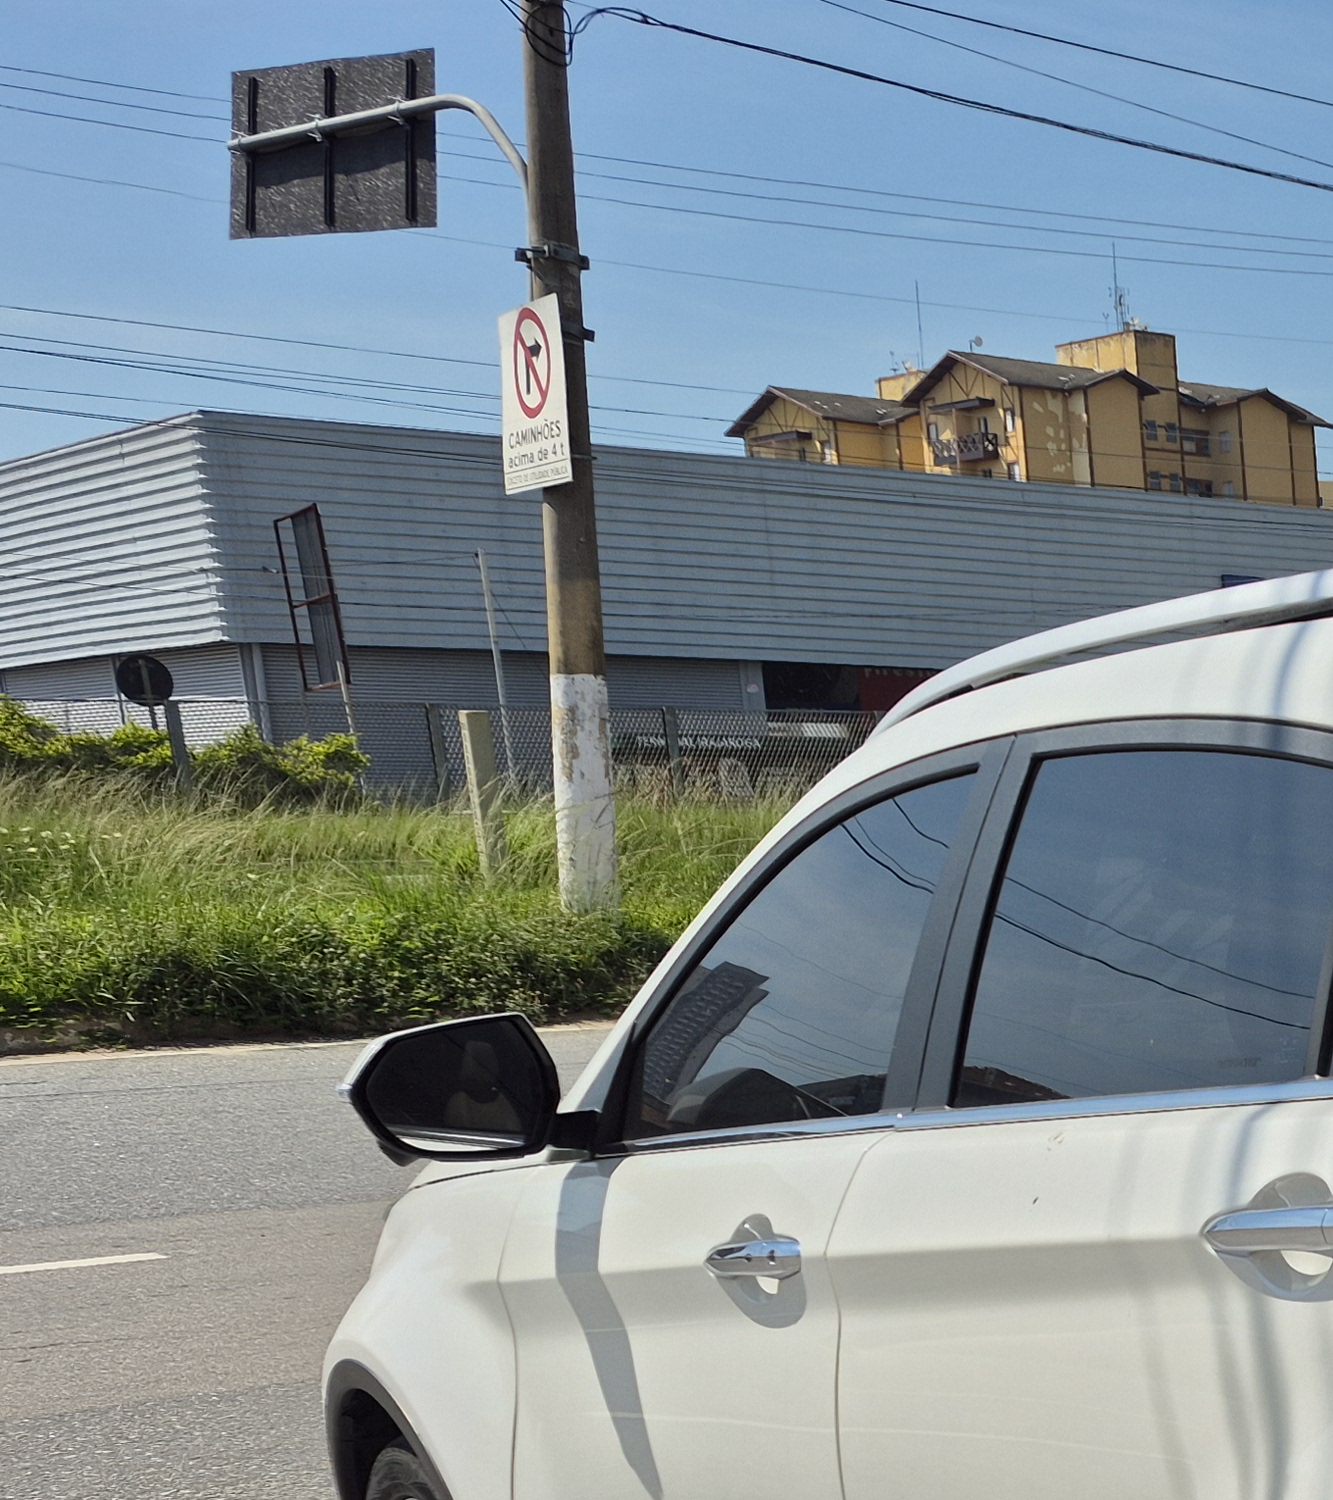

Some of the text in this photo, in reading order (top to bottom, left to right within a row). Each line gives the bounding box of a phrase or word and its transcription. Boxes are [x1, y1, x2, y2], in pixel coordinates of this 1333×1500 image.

[508, 419, 562, 449] CAMINHÕES
[508, 442, 564, 468] acima de 4 t
